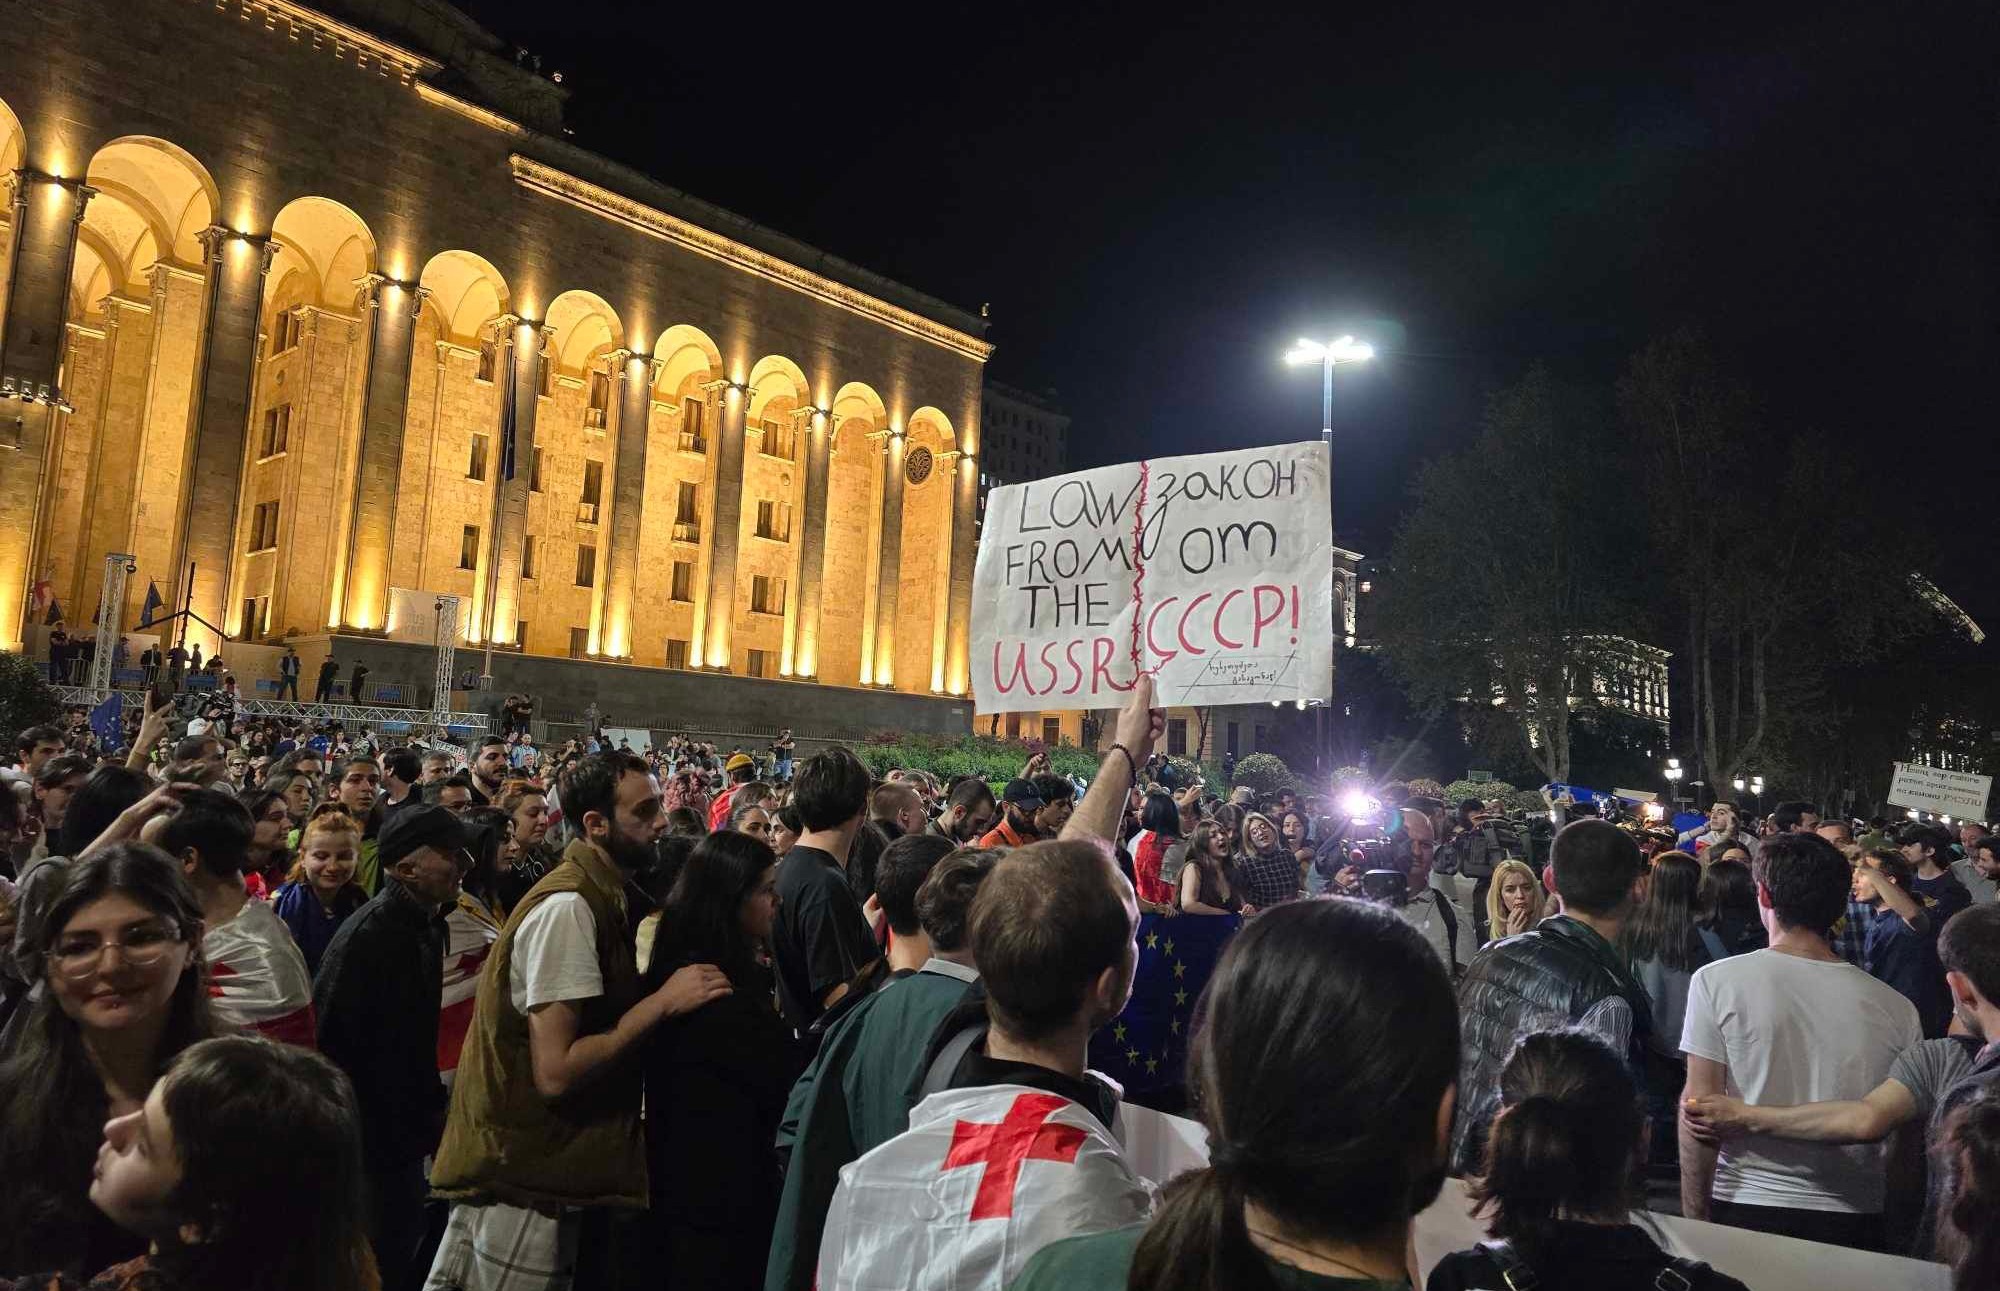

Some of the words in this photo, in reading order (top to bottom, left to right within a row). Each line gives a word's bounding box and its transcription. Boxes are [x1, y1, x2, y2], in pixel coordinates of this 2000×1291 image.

[1007, 537, 1132, 586] FROM
[1019, 582, 1109, 628] THE
[1146, 584, 1299, 656] СССР!
[993, 637, 1126, 695] USSR
